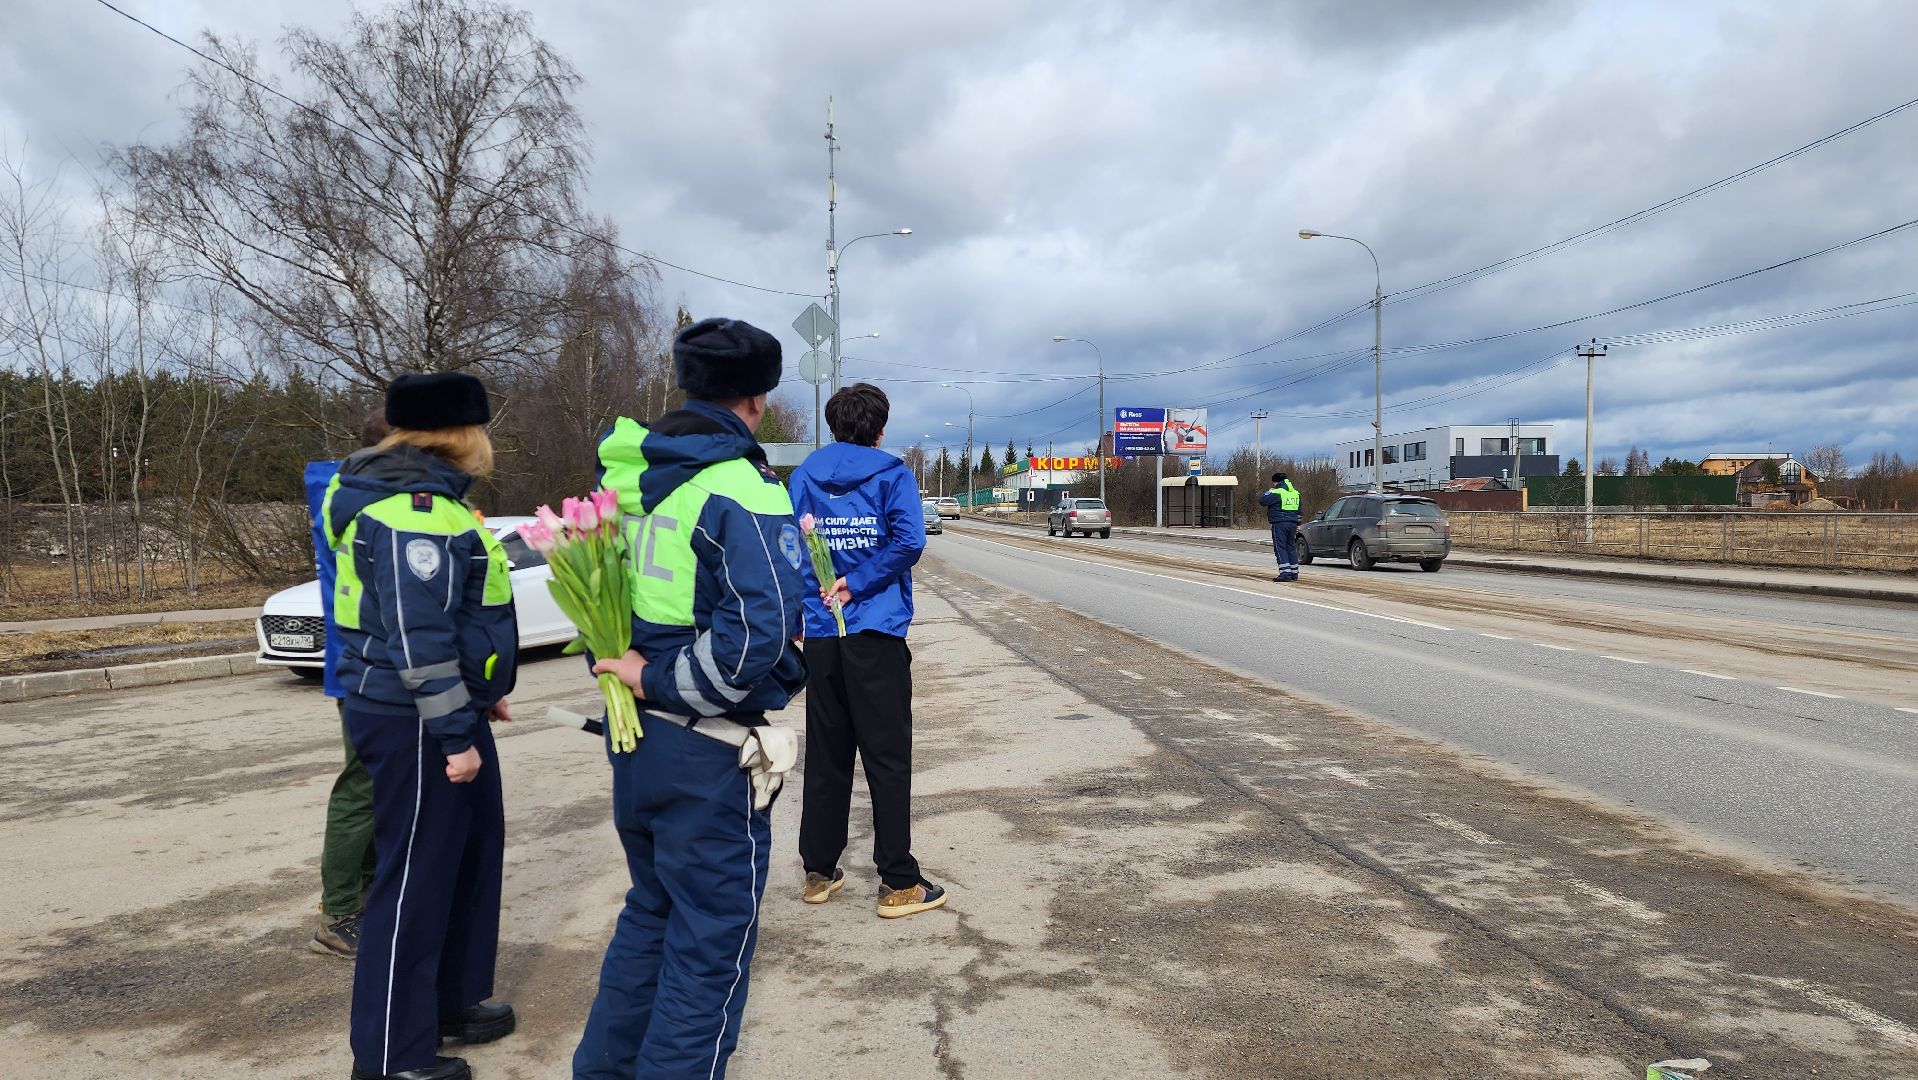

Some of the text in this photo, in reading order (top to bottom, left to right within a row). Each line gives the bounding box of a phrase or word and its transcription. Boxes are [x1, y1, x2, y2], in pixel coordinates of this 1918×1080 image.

[825, 517, 849, 526] СИЛУ
[850, 516, 878, 526] ДАЕТ
[831, 527, 878, 535] ВЕРНОСТЬ
[621, 513, 678, 582] ПС
